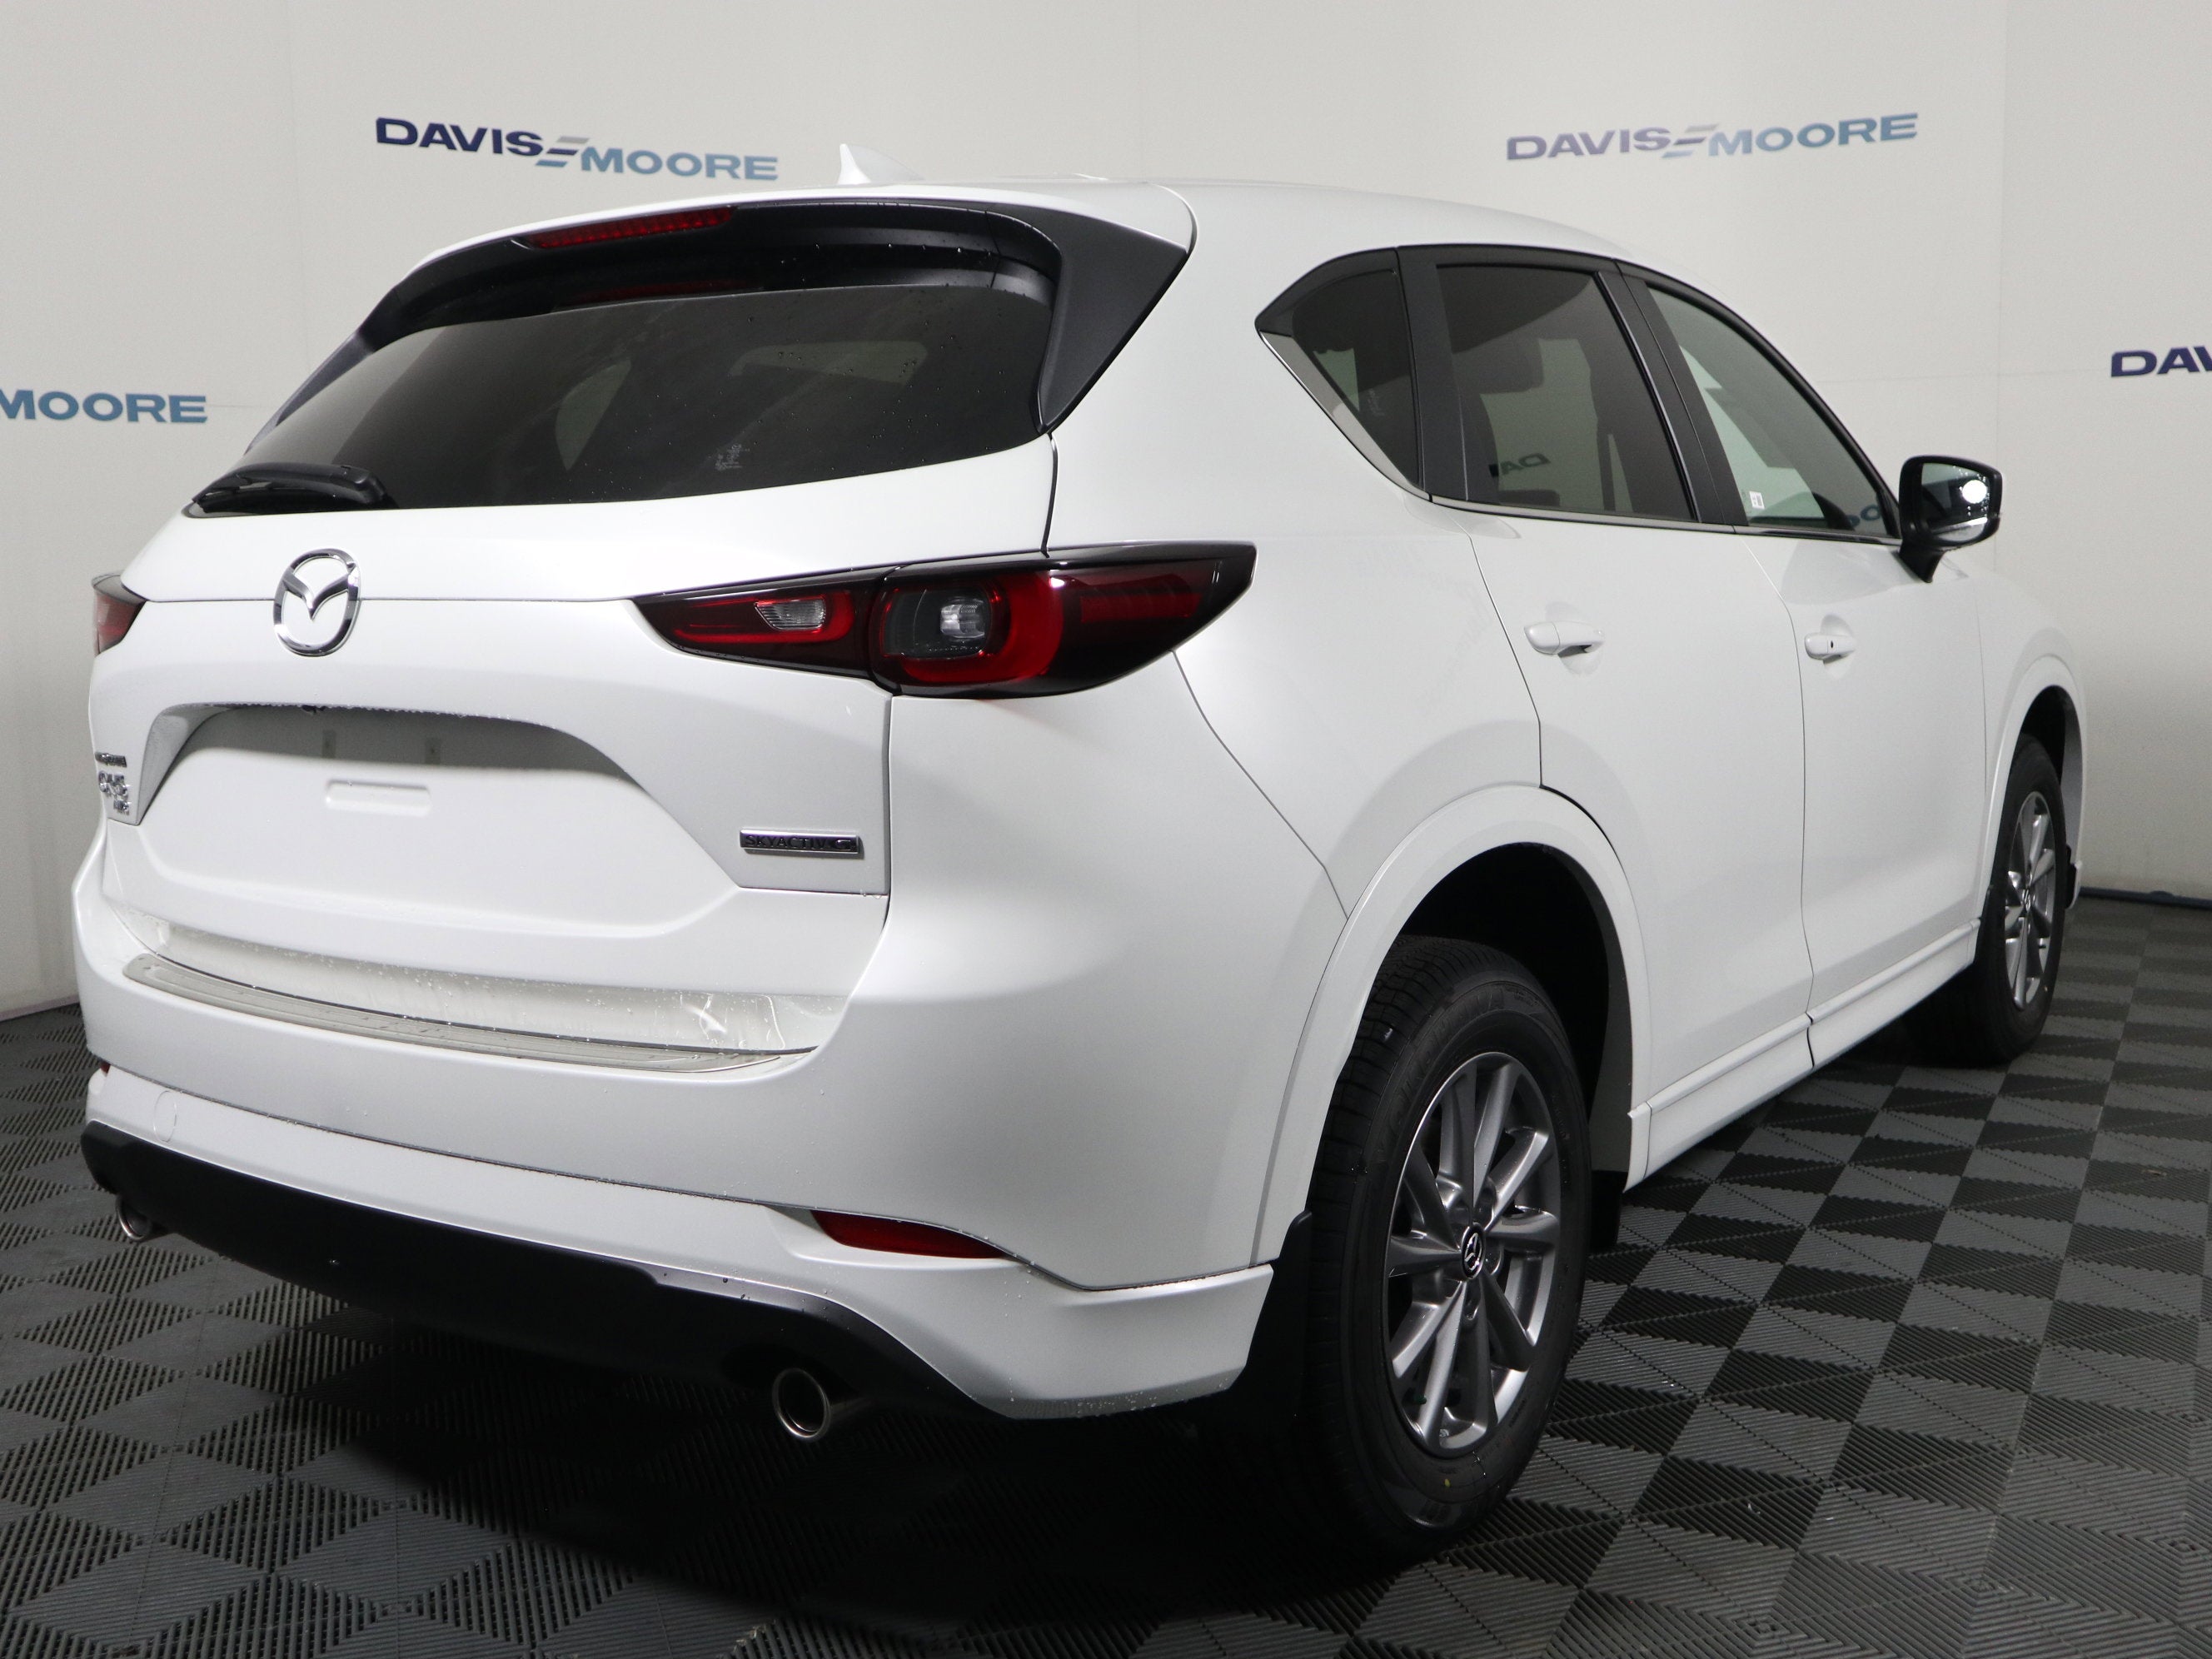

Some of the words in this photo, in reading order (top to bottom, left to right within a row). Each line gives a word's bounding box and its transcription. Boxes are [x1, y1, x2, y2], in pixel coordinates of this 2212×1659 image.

[376, 117, 544, 157] DAVIS
[581, 146, 779, 181] MOORE
[1507, 126, 1671, 161] DAVIS
[1707, 112, 1919, 157] MOORE
[0, 389, 208, 423] MOORE
[745, 834, 827, 849] SKYACTIV
